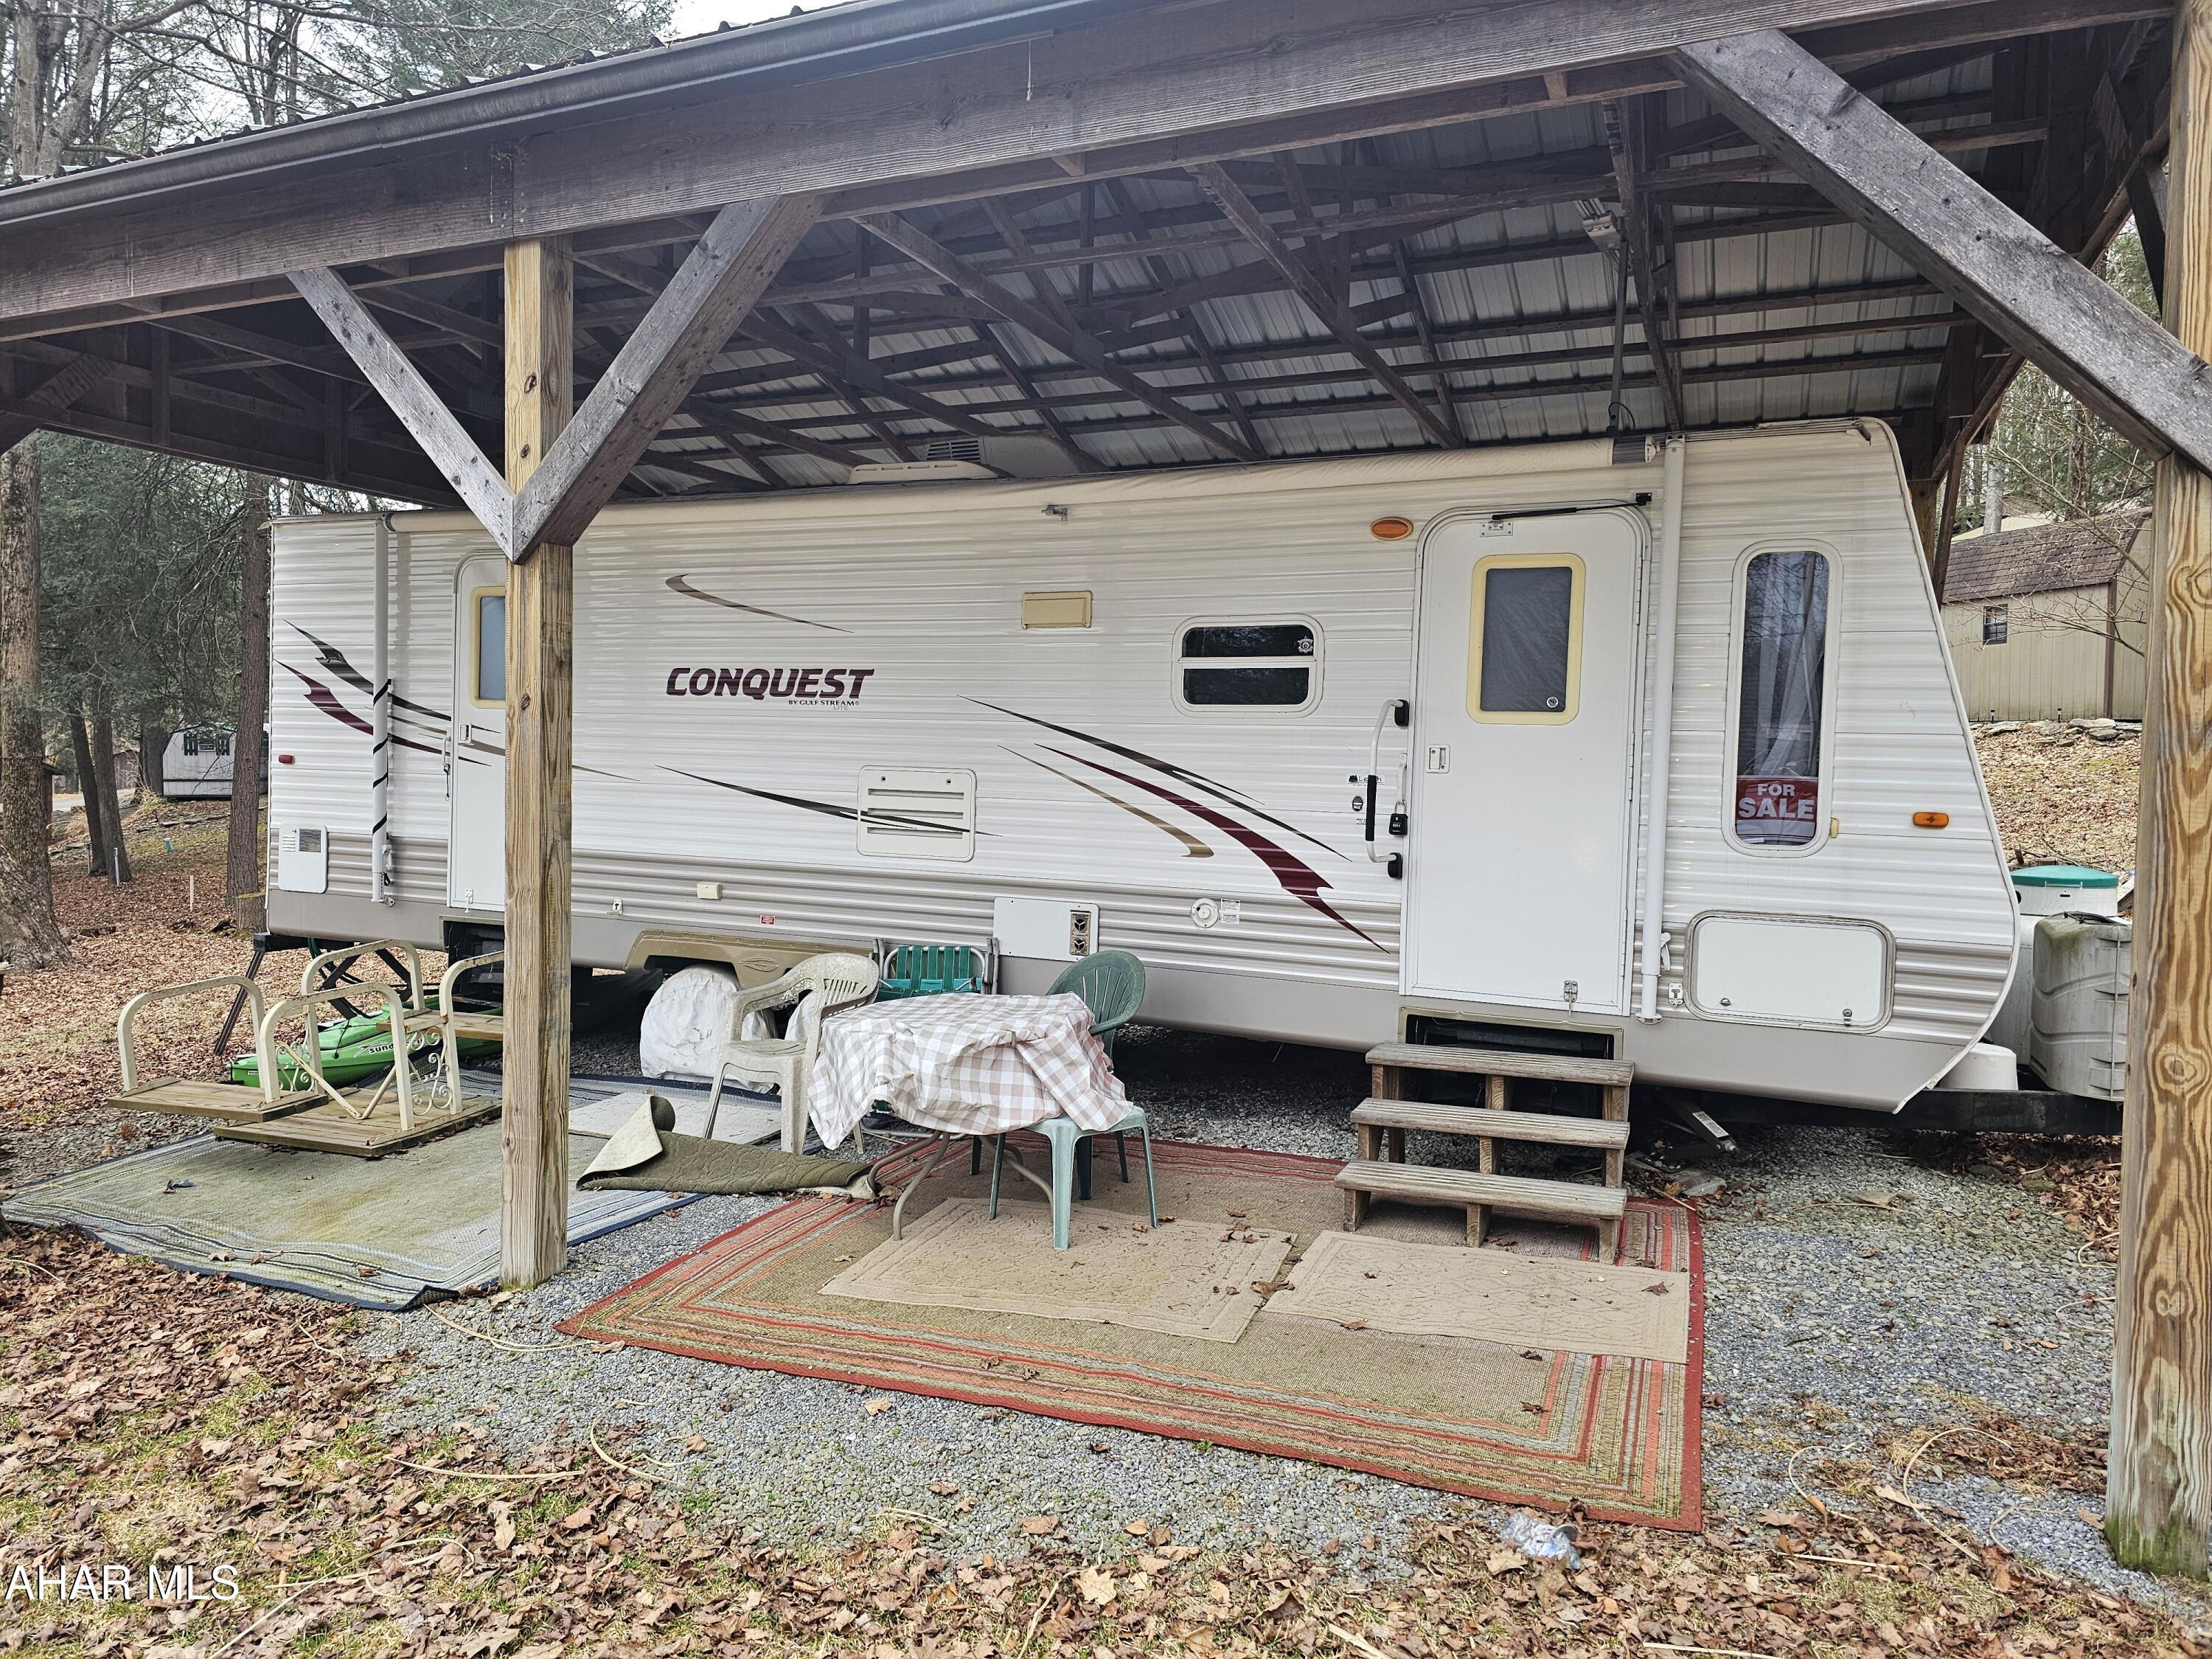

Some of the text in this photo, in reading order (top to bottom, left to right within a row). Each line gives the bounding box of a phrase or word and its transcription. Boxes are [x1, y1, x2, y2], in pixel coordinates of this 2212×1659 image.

[667, 667, 875, 700] CONQUEST
[1757, 784, 1795, 796] FOR
[1739, 797, 1815, 820] SALE
